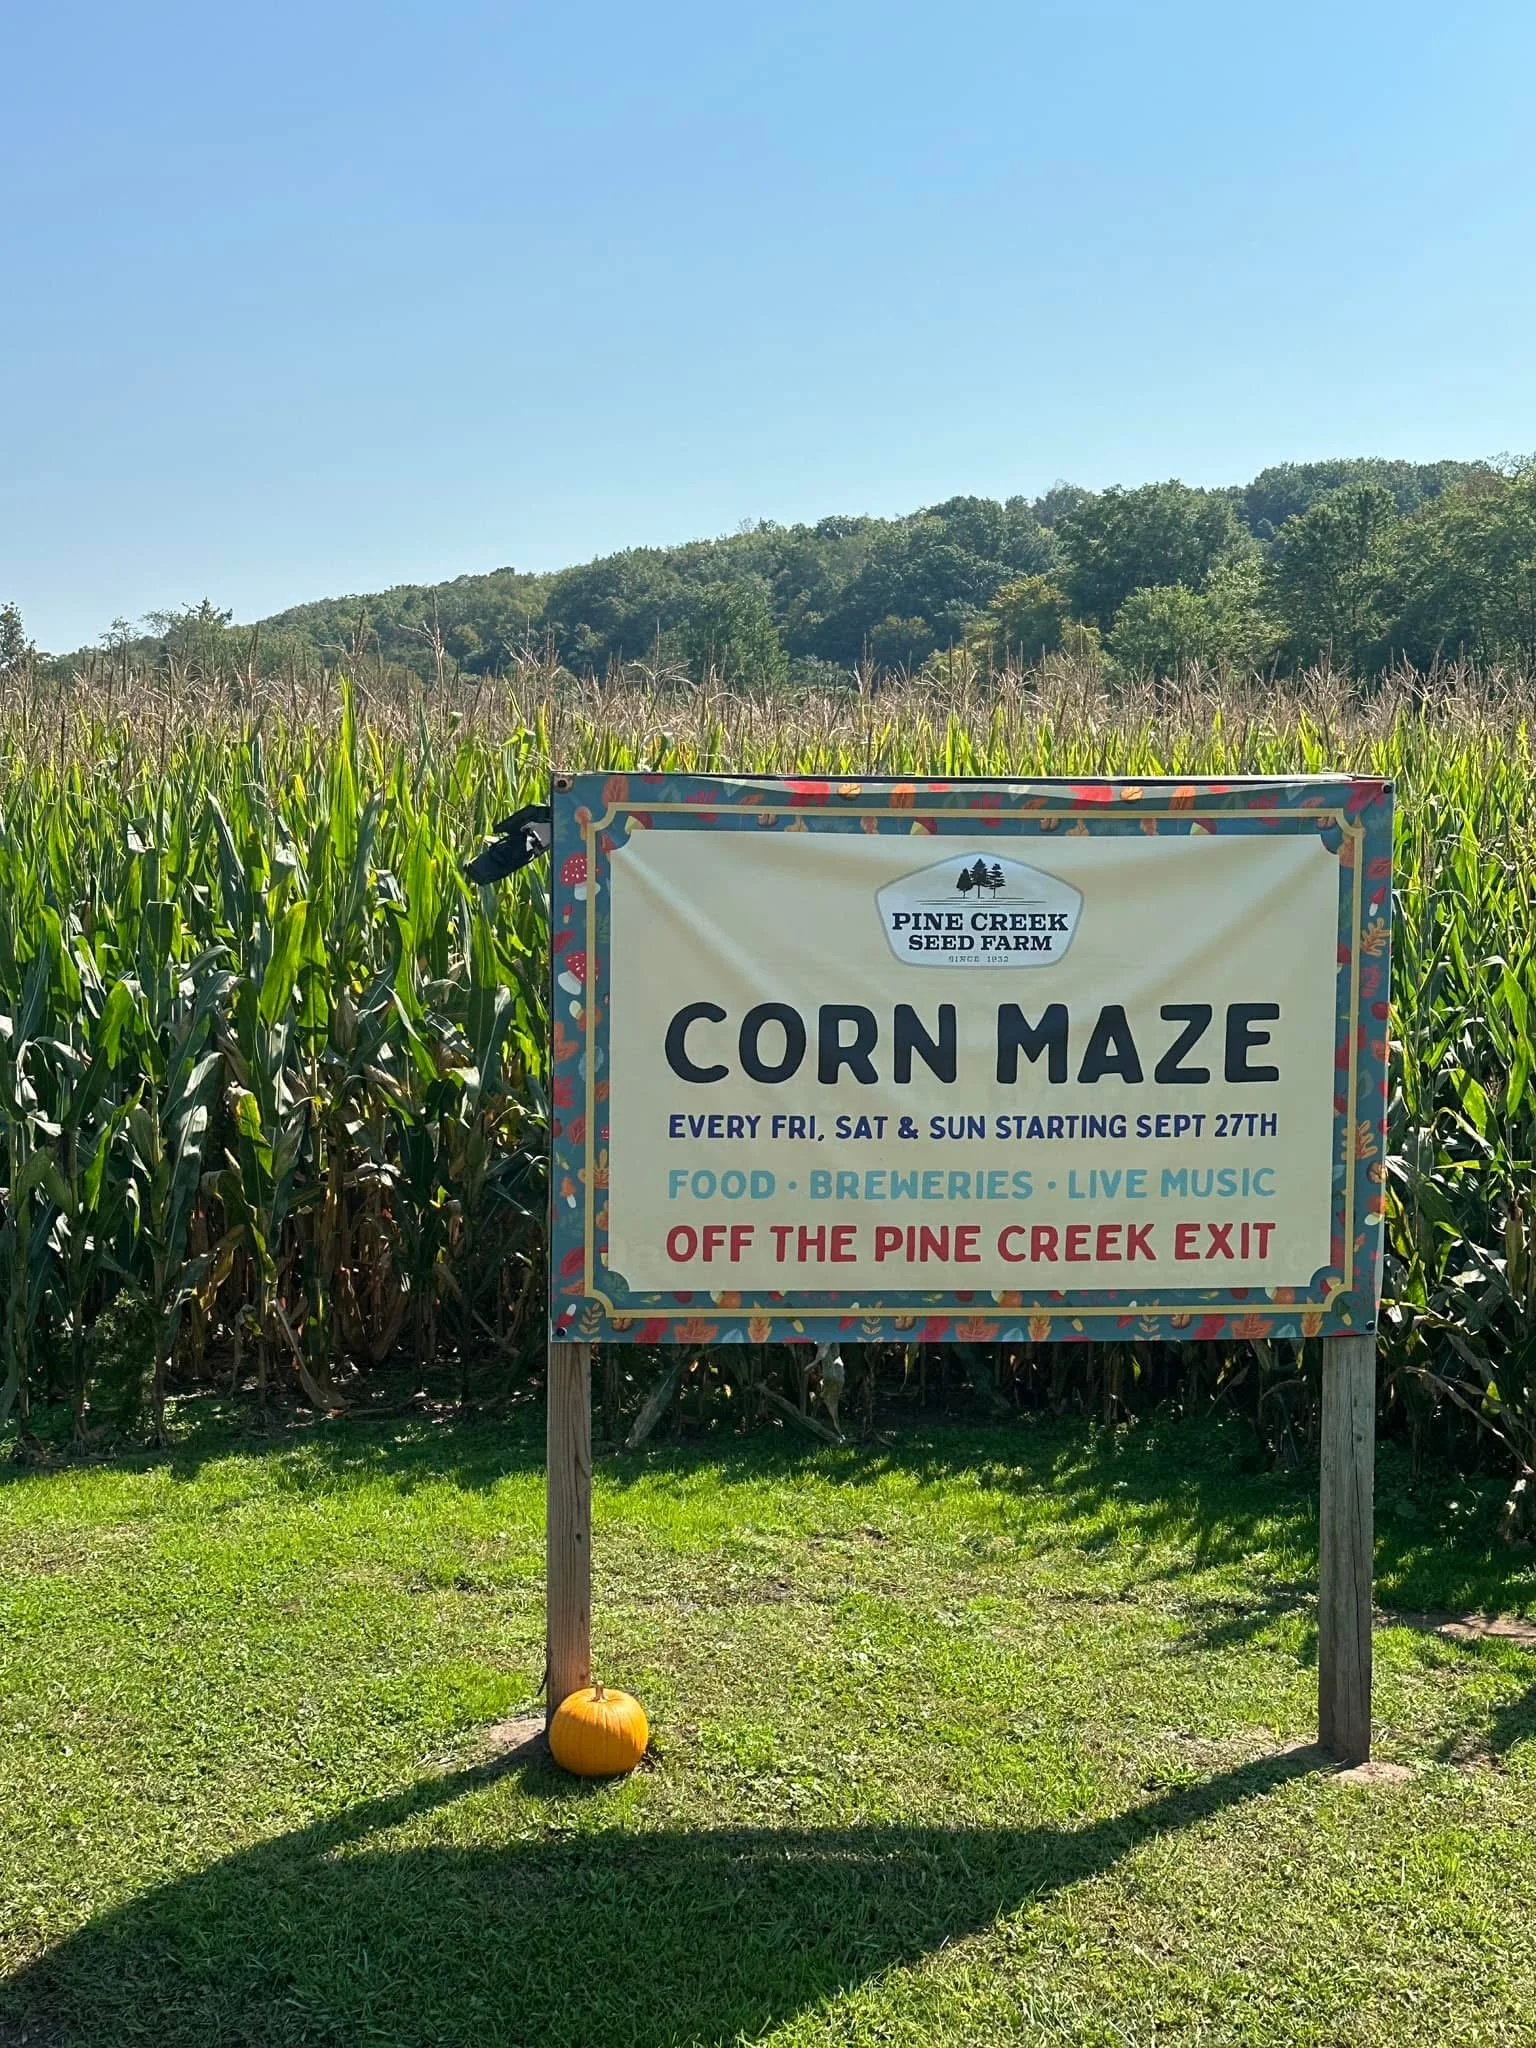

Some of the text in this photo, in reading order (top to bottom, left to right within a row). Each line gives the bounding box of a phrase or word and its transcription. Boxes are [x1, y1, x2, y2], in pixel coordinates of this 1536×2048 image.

[891, 912, 1069, 932] PINE CREEK
[908, 934, 1053, 952] SEED FARM
[948, 955, 980, 963] SINCE
[664, 1001, 1280, 1085] CORN MAZE
[668, 1112, 1278, 1142] EVERY FRI, SAT & SUN STARTING SEPT 27TH
[668, 1167, 1277, 1200] FOOD BREWERIES LIVE MUSIC
[666, 1222, 1277, 1263] OFF THE PINE CREEK EXIT
